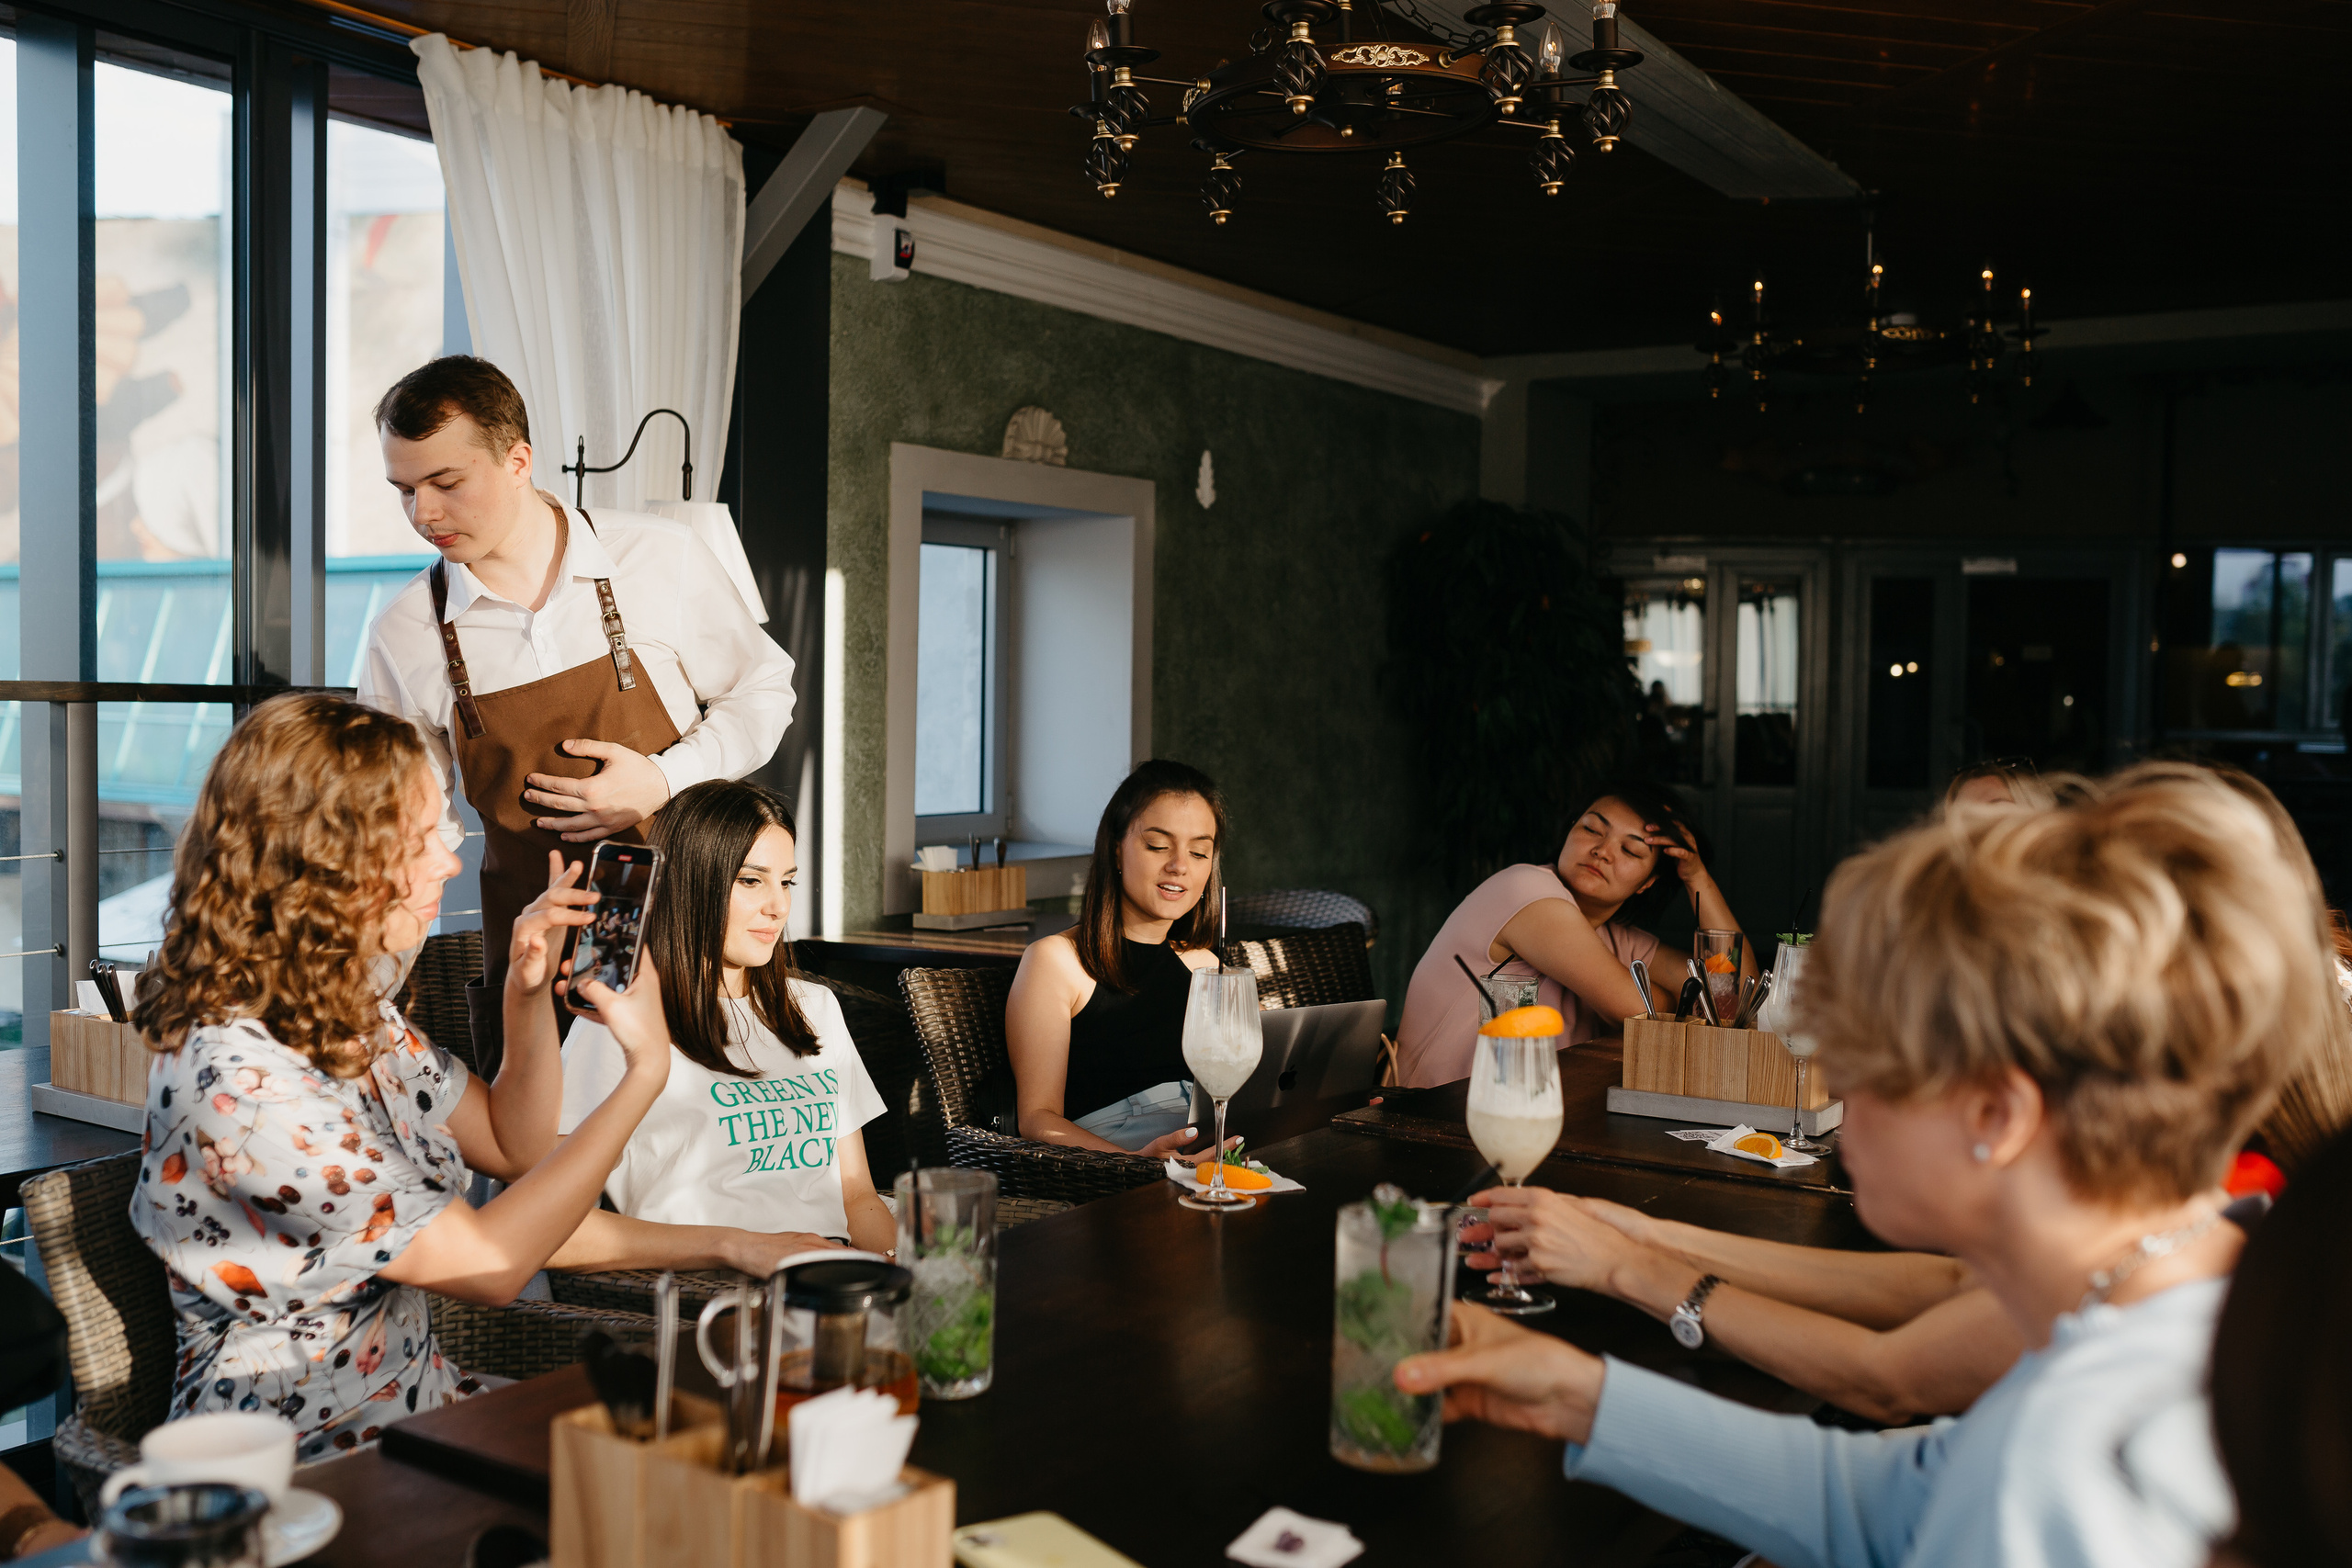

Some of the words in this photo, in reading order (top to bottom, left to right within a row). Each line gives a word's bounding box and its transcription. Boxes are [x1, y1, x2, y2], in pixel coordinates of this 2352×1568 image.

[710, 1075, 817, 1108] GREEN
[810, 1068, 838, 1095] IS
[718, 1108, 788, 1146] THE
[742, 1136, 837, 1175] BLACK
